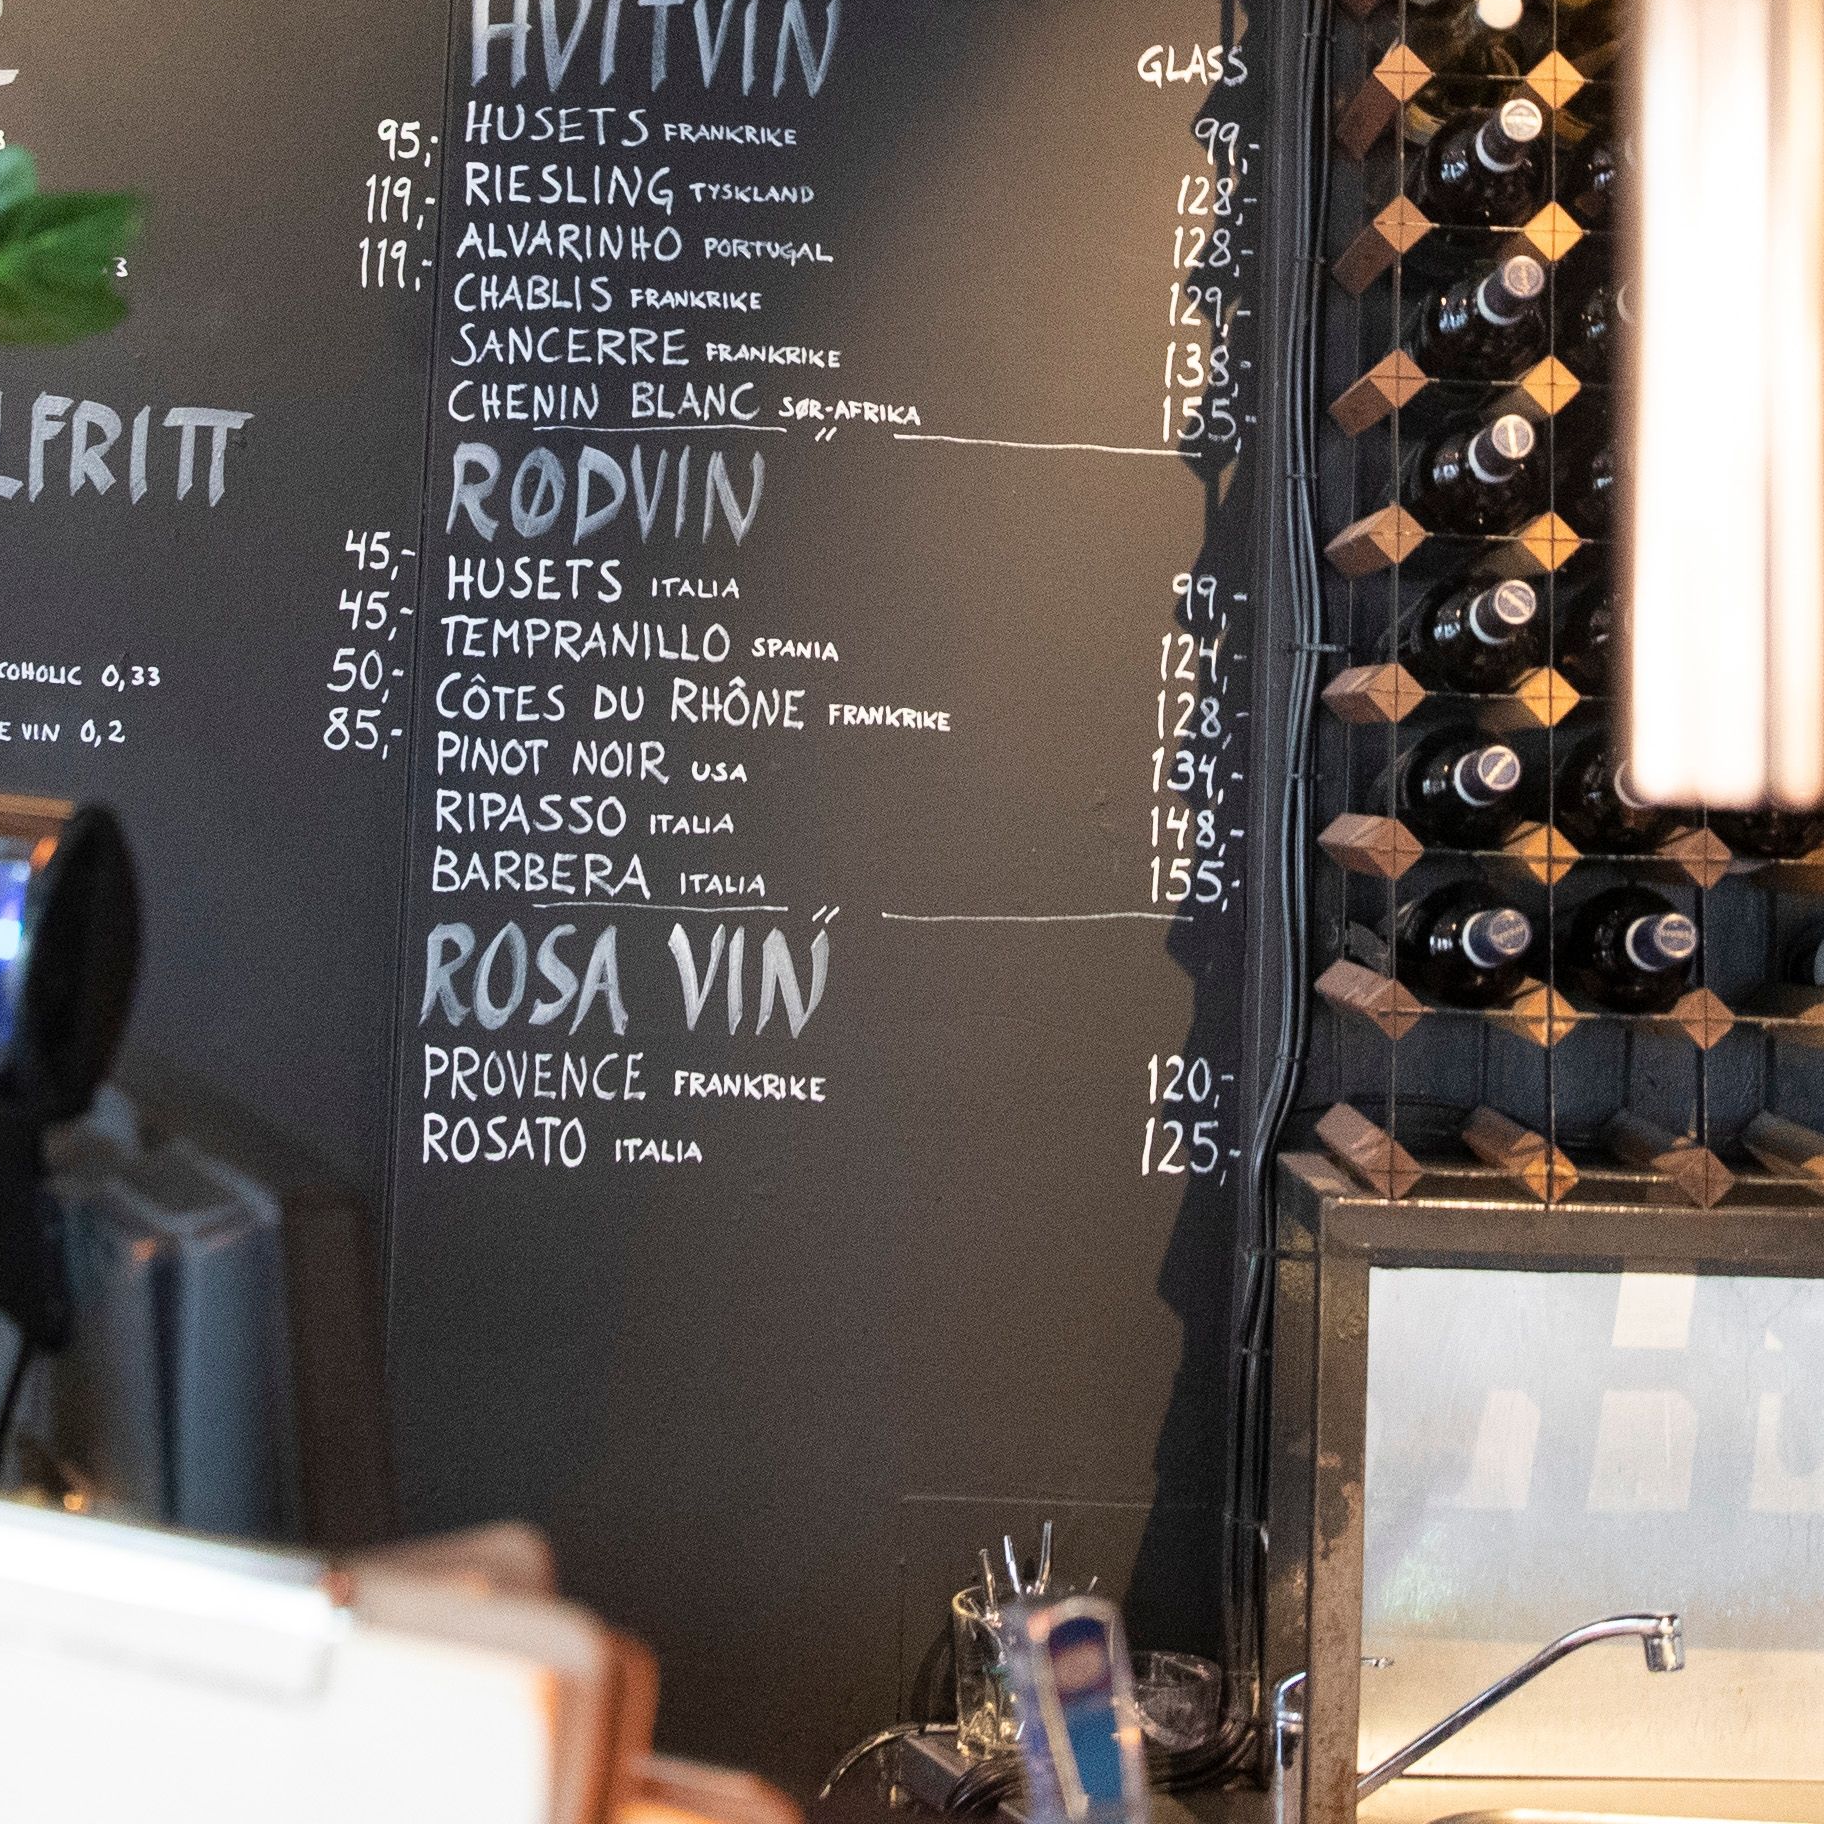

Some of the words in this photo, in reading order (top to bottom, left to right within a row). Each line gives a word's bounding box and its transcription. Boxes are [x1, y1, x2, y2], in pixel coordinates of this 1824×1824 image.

[1136, 43, 1249, 88] GLASS
[376, 117, 439, 168] 95,-
[464, 99, 650, 148] HUSETS
[662, 121, 797, 148] FRANKRIKE
[464, 160, 675, 216] RIESLING
[688, 181, 815, 204] TYSKLAND
[455, 219, 683, 263] ALVARINHO
[703, 236, 835, 267] PORTUGAL
[452, 272, 613, 314] CHABLIS
[629, 287, 761, 313] FRANKRIKE
[450, 321, 690, 368] SANCERRE
[705, 341, 841, 369] FRANKRIKE
[447, 379, 600, 423] CHENIN
[630, 381, 758, 422] BLANC
[445, 441, 765, 545] RØDVIN
[446, 554, 623, 604] HUSETS
[650, 576, 741, 600] ITALIA
[439, 613, 731, 664] TEMPRANILLO
[751, 636, 840, 662] SPANIA
[434, 671, 566, 723] CÔTES
[592, 684, 645, 722] DU
[669, 675, 806, 731] RHÔNE
[828, 702, 951, 733] FRANKRIKE
[436, 729, 550, 776] PINOT
[571, 740, 670, 785] NOIR
[690, 760, 748, 783] USA
[1151, 746, 1243, 804] 134,-
[434, 787, 628, 838] RIPASSO
[648, 813, 735, 835] ITALIA
[430, 845, 652, 900] BARBERA
[679, 872, 767, 897] ITALIA
[419, 921, 629, 1037] ROSA
[422, 1043, 647, 1102] PROVENCE
[673, 1069, 826, 1103] FRANKRIKE
[421, 1111, 588, 1169] ROSATO
[614, 1137, 704, 1164] ITALIA
